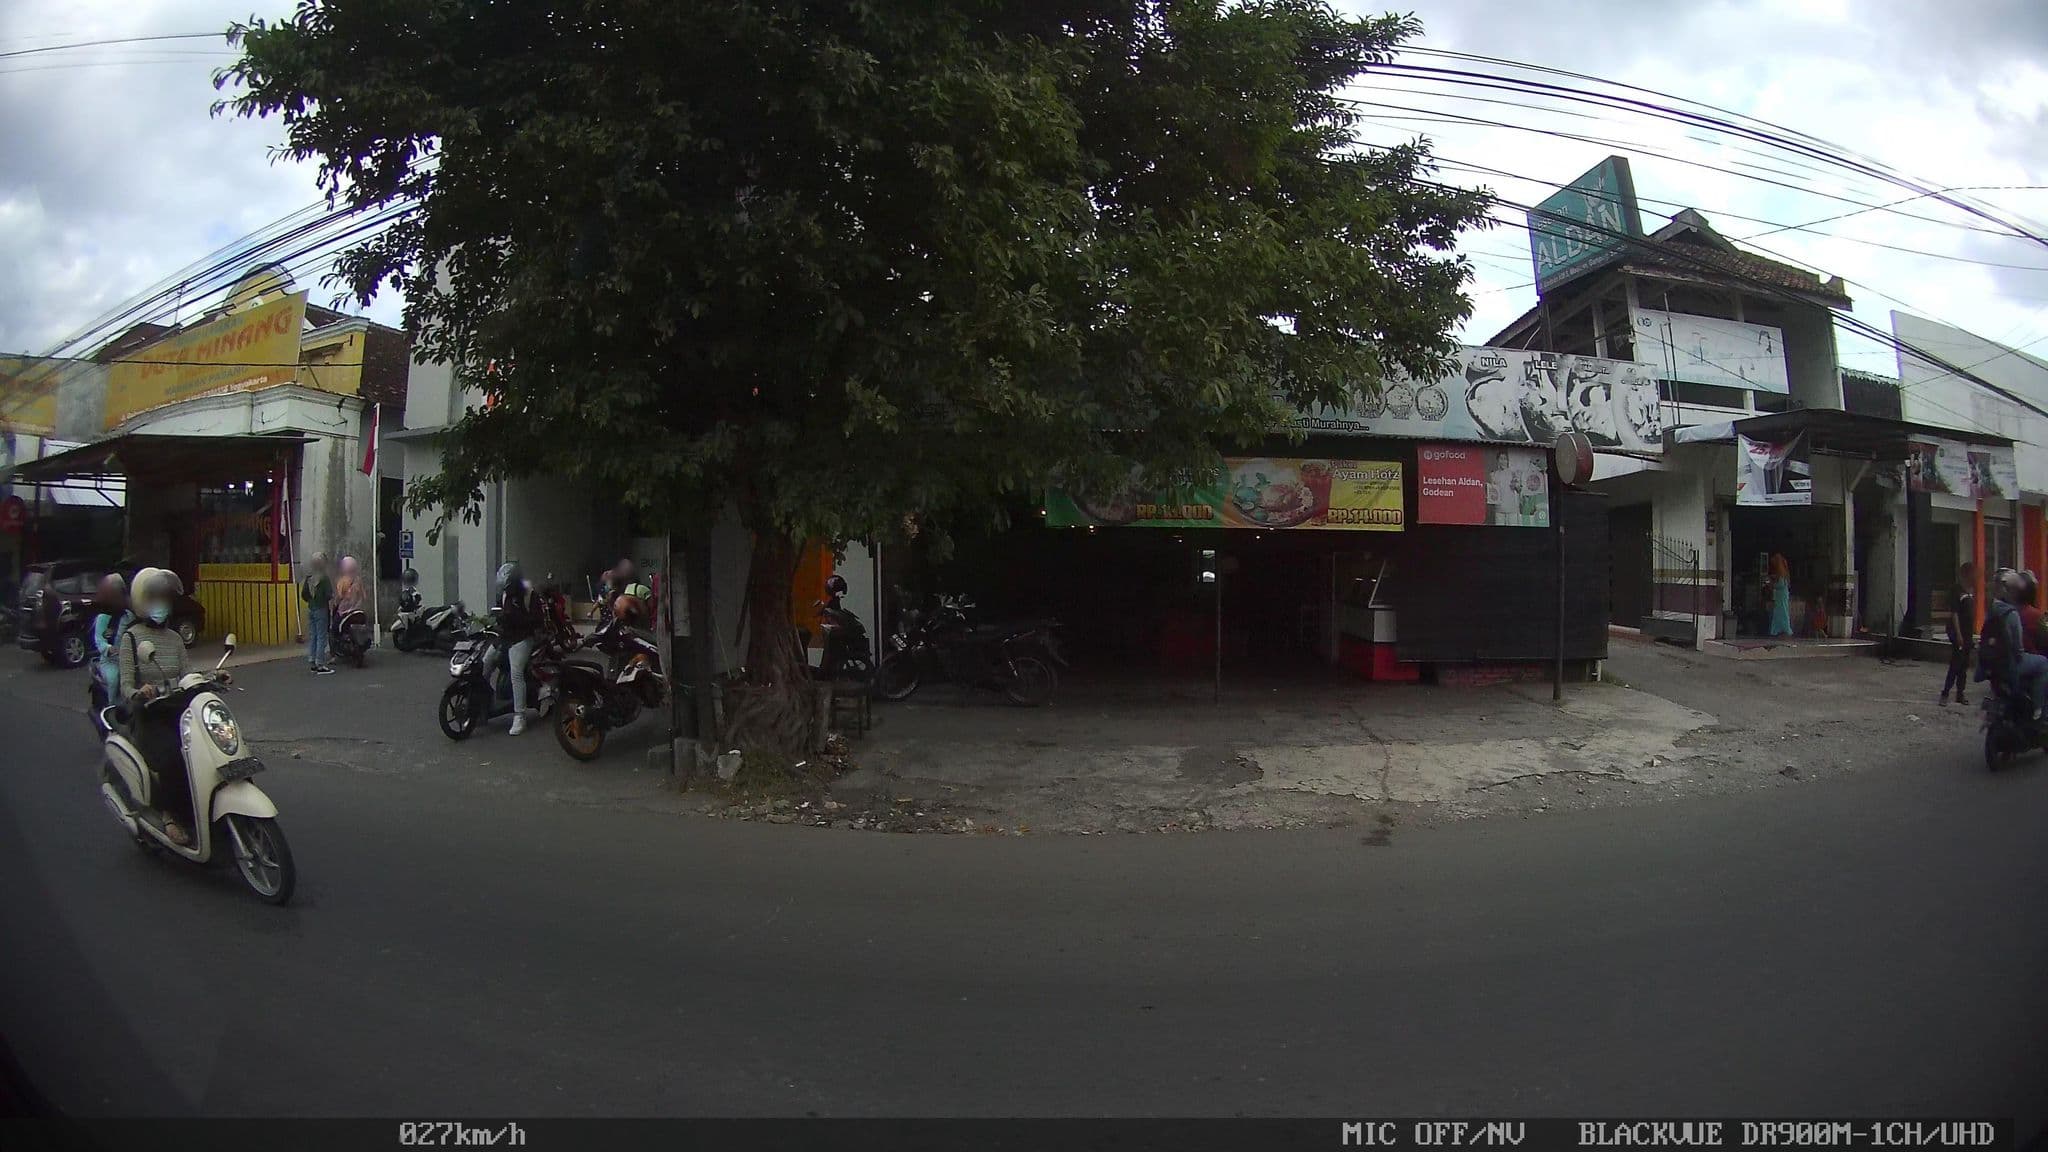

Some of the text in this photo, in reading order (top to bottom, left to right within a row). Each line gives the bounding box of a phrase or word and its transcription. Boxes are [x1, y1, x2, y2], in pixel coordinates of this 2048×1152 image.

[1537, 200, 1622, 273] ALDAN
[198, 307, 293, 357] MINANG
[1480, 356, 1508, 368] NILA
[1533, 358, 1558, 371] LELE
[1433, 450, 1466, 461] gofood
[1332, 468, 1401, 481] Ayam Hotz
[1423, 476, 1484, 488] Lesehan Aldan,
[1423, 488, 1455, 497] Godean
[402, 533, 411, 549] P
